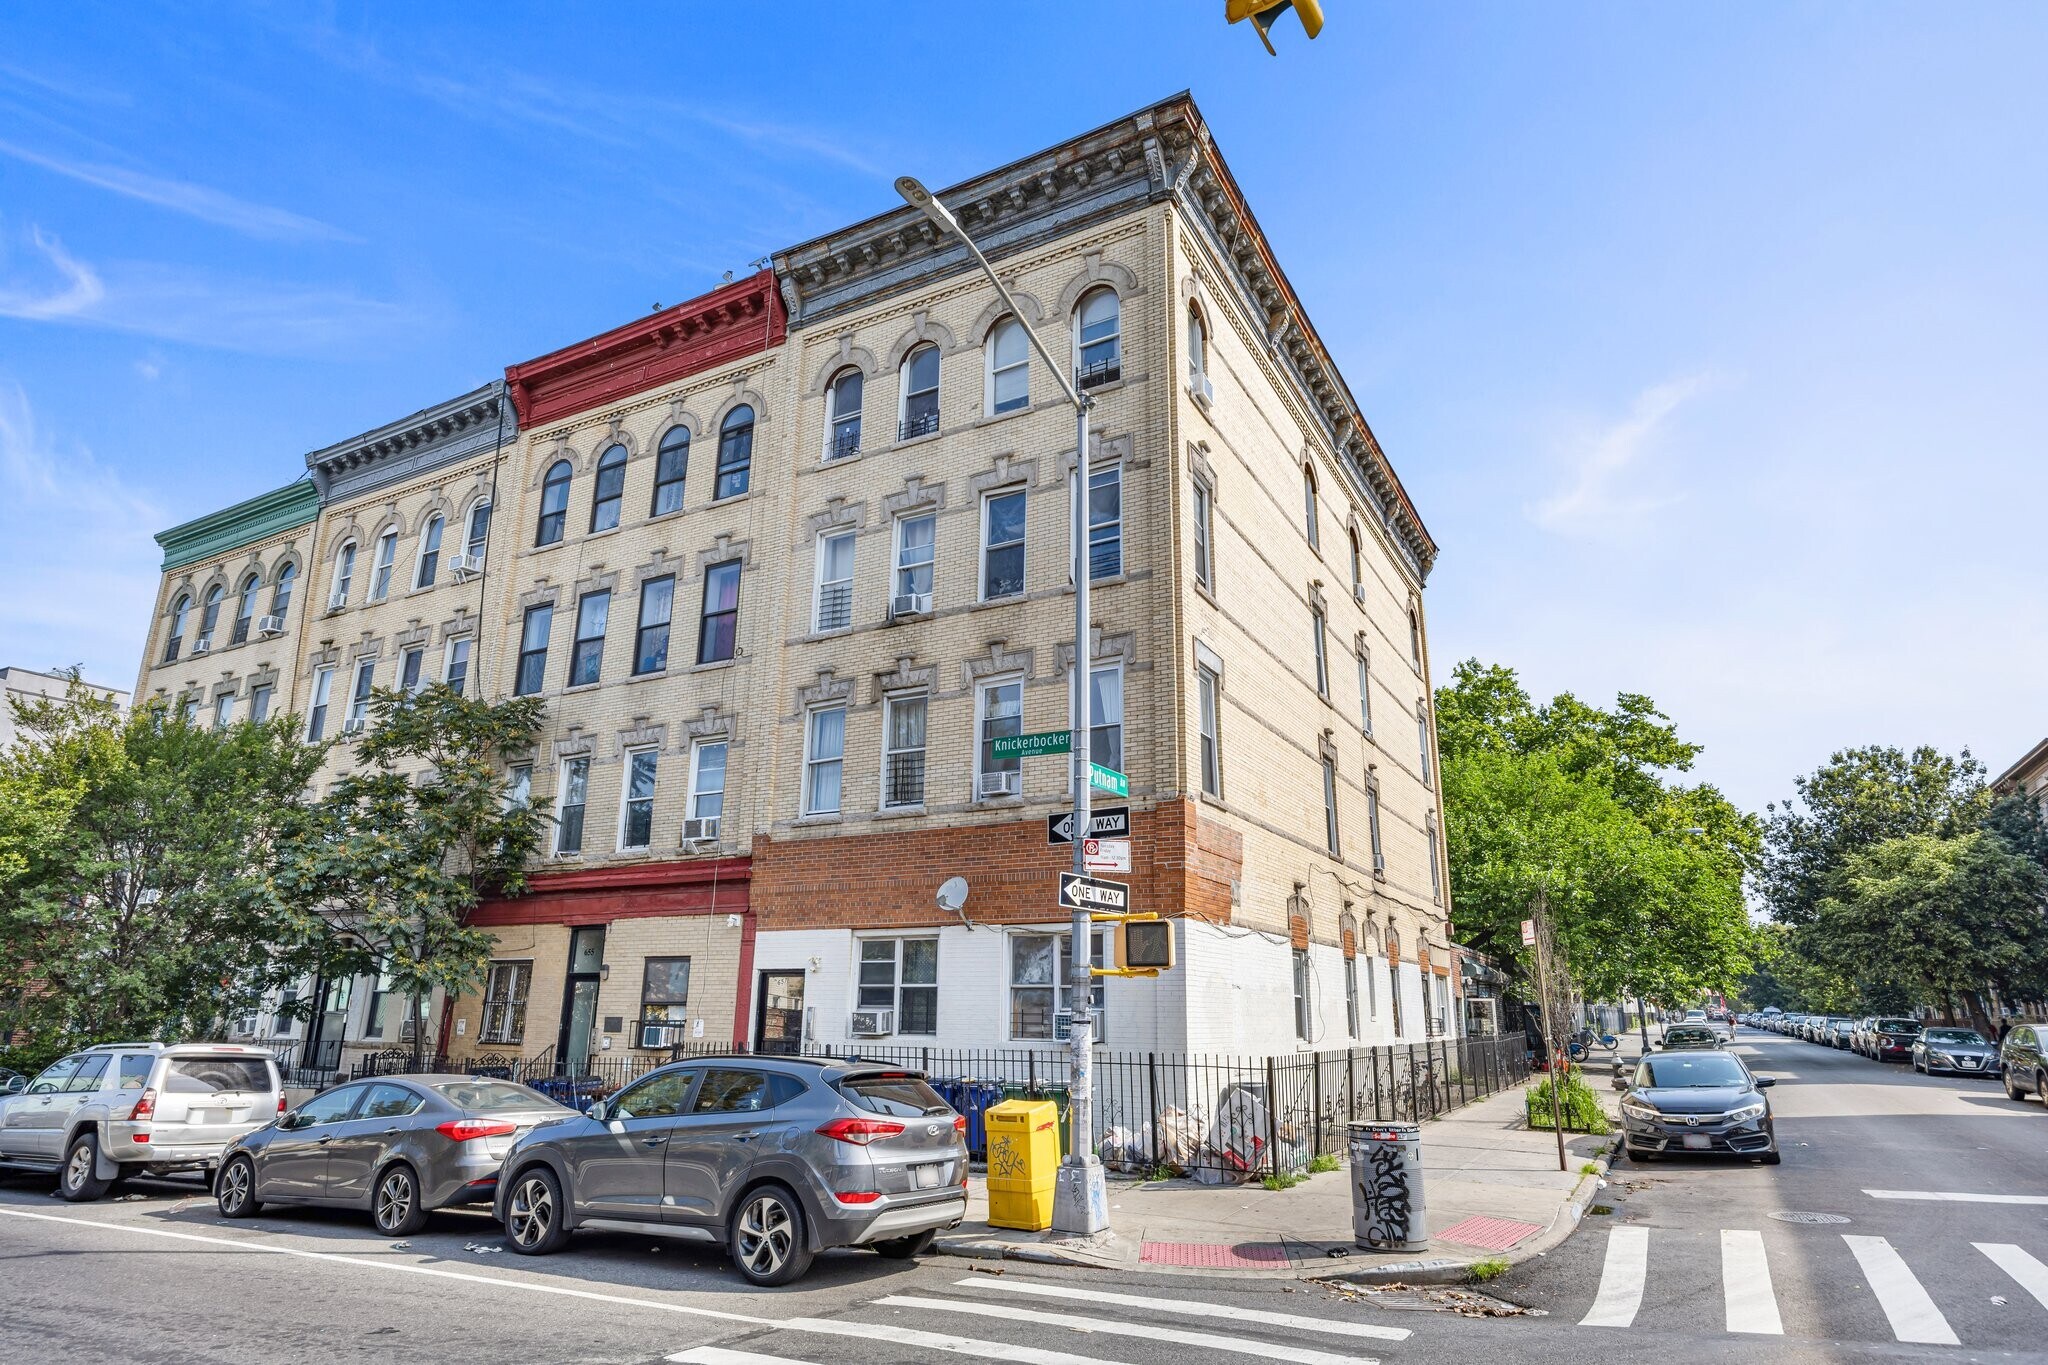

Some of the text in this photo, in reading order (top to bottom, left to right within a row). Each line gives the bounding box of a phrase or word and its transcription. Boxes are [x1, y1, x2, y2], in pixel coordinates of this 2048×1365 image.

[995, 733, 1070, 751] Knickerbocker
[1089, 764, 1117, 791] Putnam
[1096, 816, 1120, 830] WAY
[1072, 884, 1120, 904] ONE WAY
